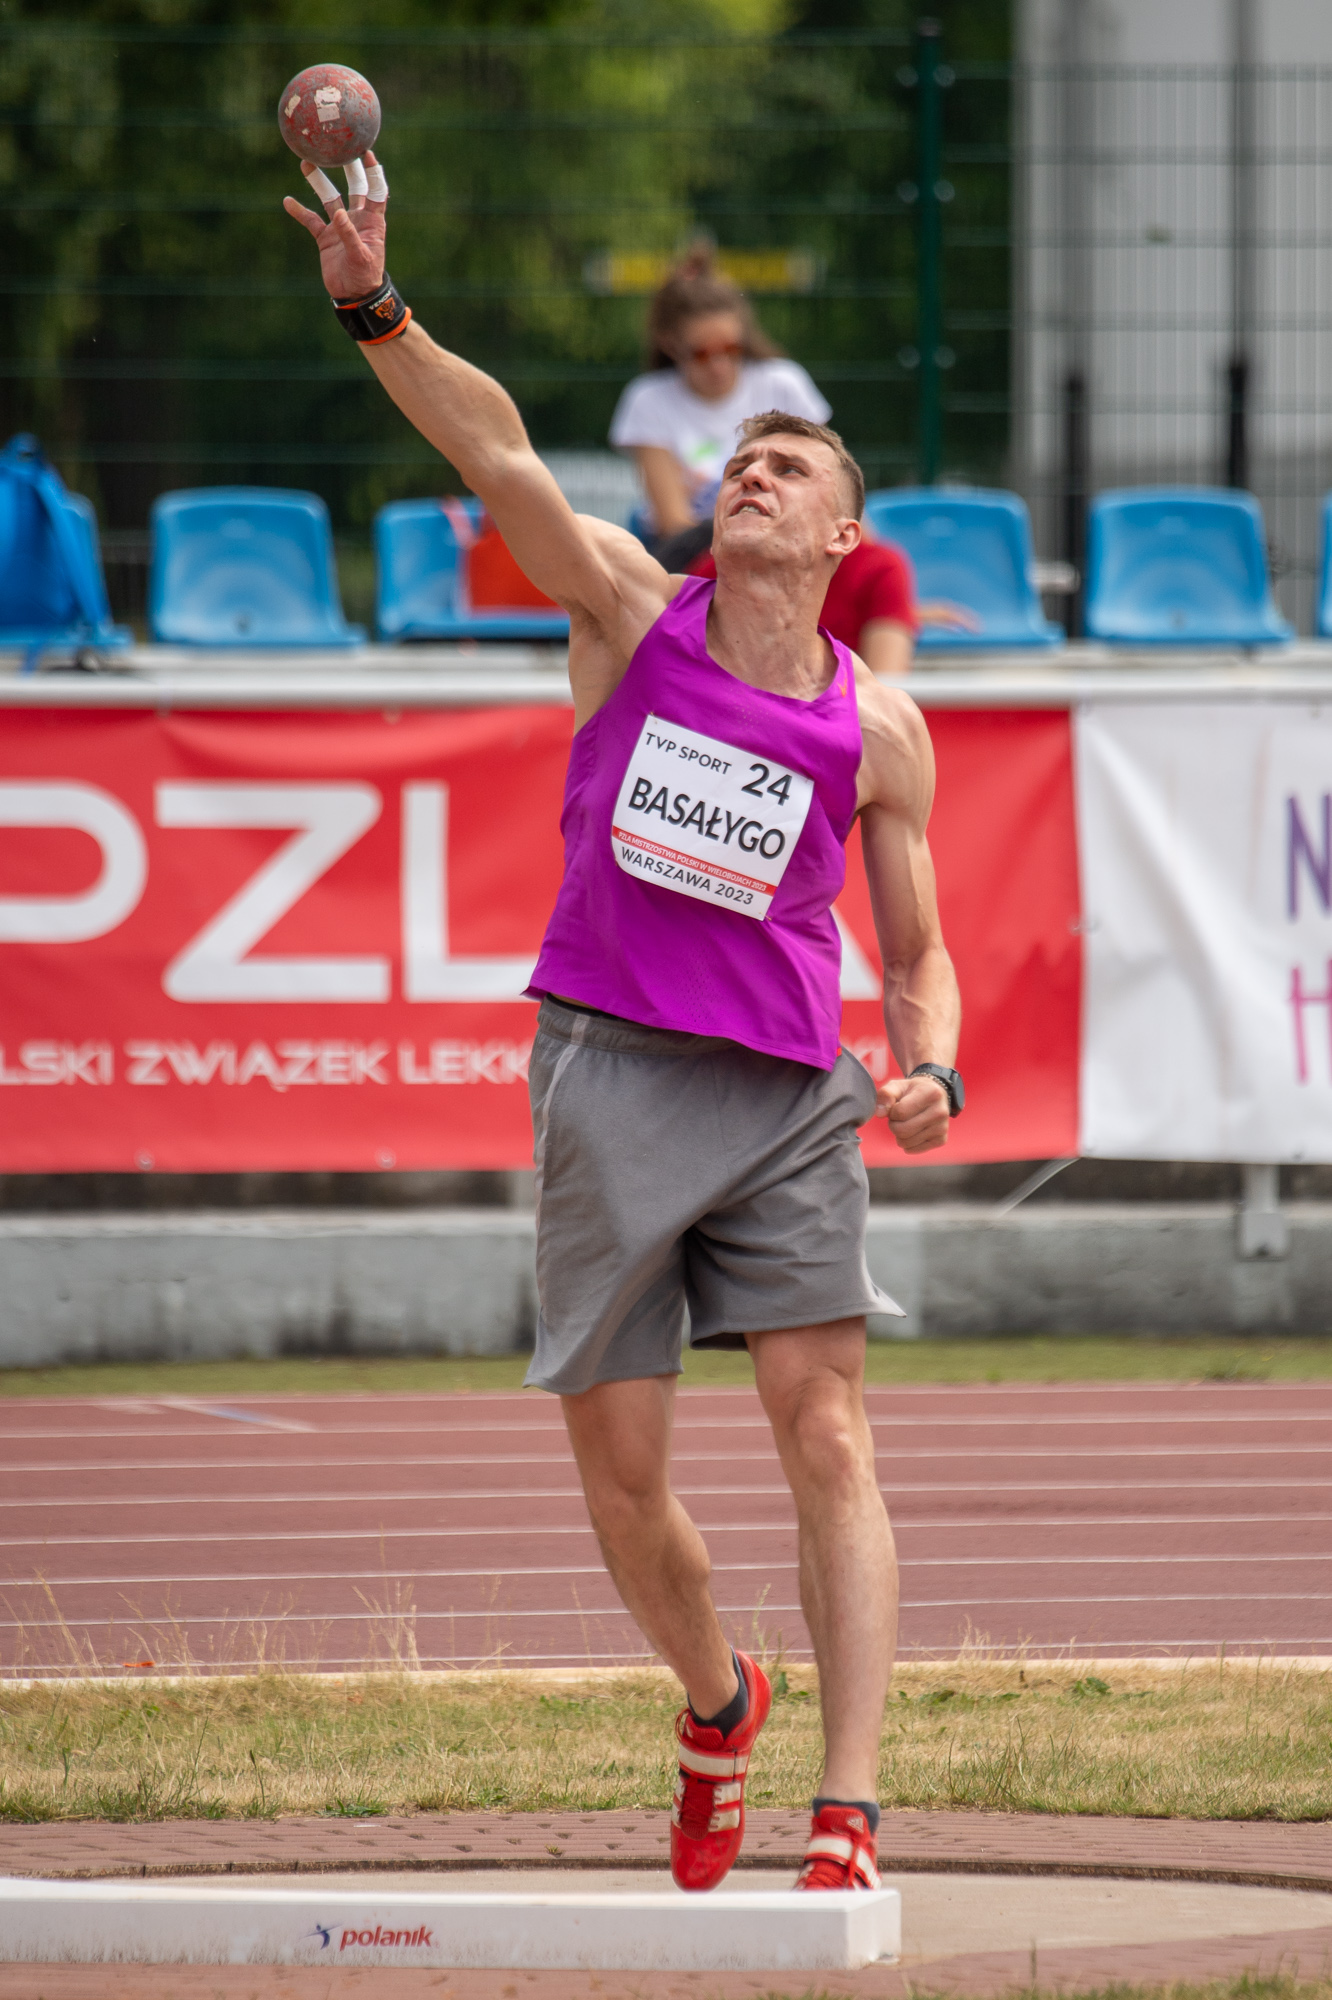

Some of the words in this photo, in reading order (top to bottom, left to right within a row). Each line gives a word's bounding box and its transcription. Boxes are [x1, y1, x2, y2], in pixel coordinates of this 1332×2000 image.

[646, 732, 677, 753] TVP
[678, 746, 732, 775] SPORT
[741, 763, 793, 806] 24
[628, 776, 786, 860] BASAŁYGO
[621, 846, 711, 892] WARSZAWA
[714, 883, 754, 905] 2023
[632, 837, 676, 860] MISTRZOSTWA
[677, 856, 700, 868] POLSKI
[699, 862, 708, 871] W
[707, 865, 752, 887] WIELOBOJACH
[751, 881, 767, 892] 2023
[123, 1038, 391, 1093] ZWIĄZEK
[340, 1924, 434, 1952] polanik
